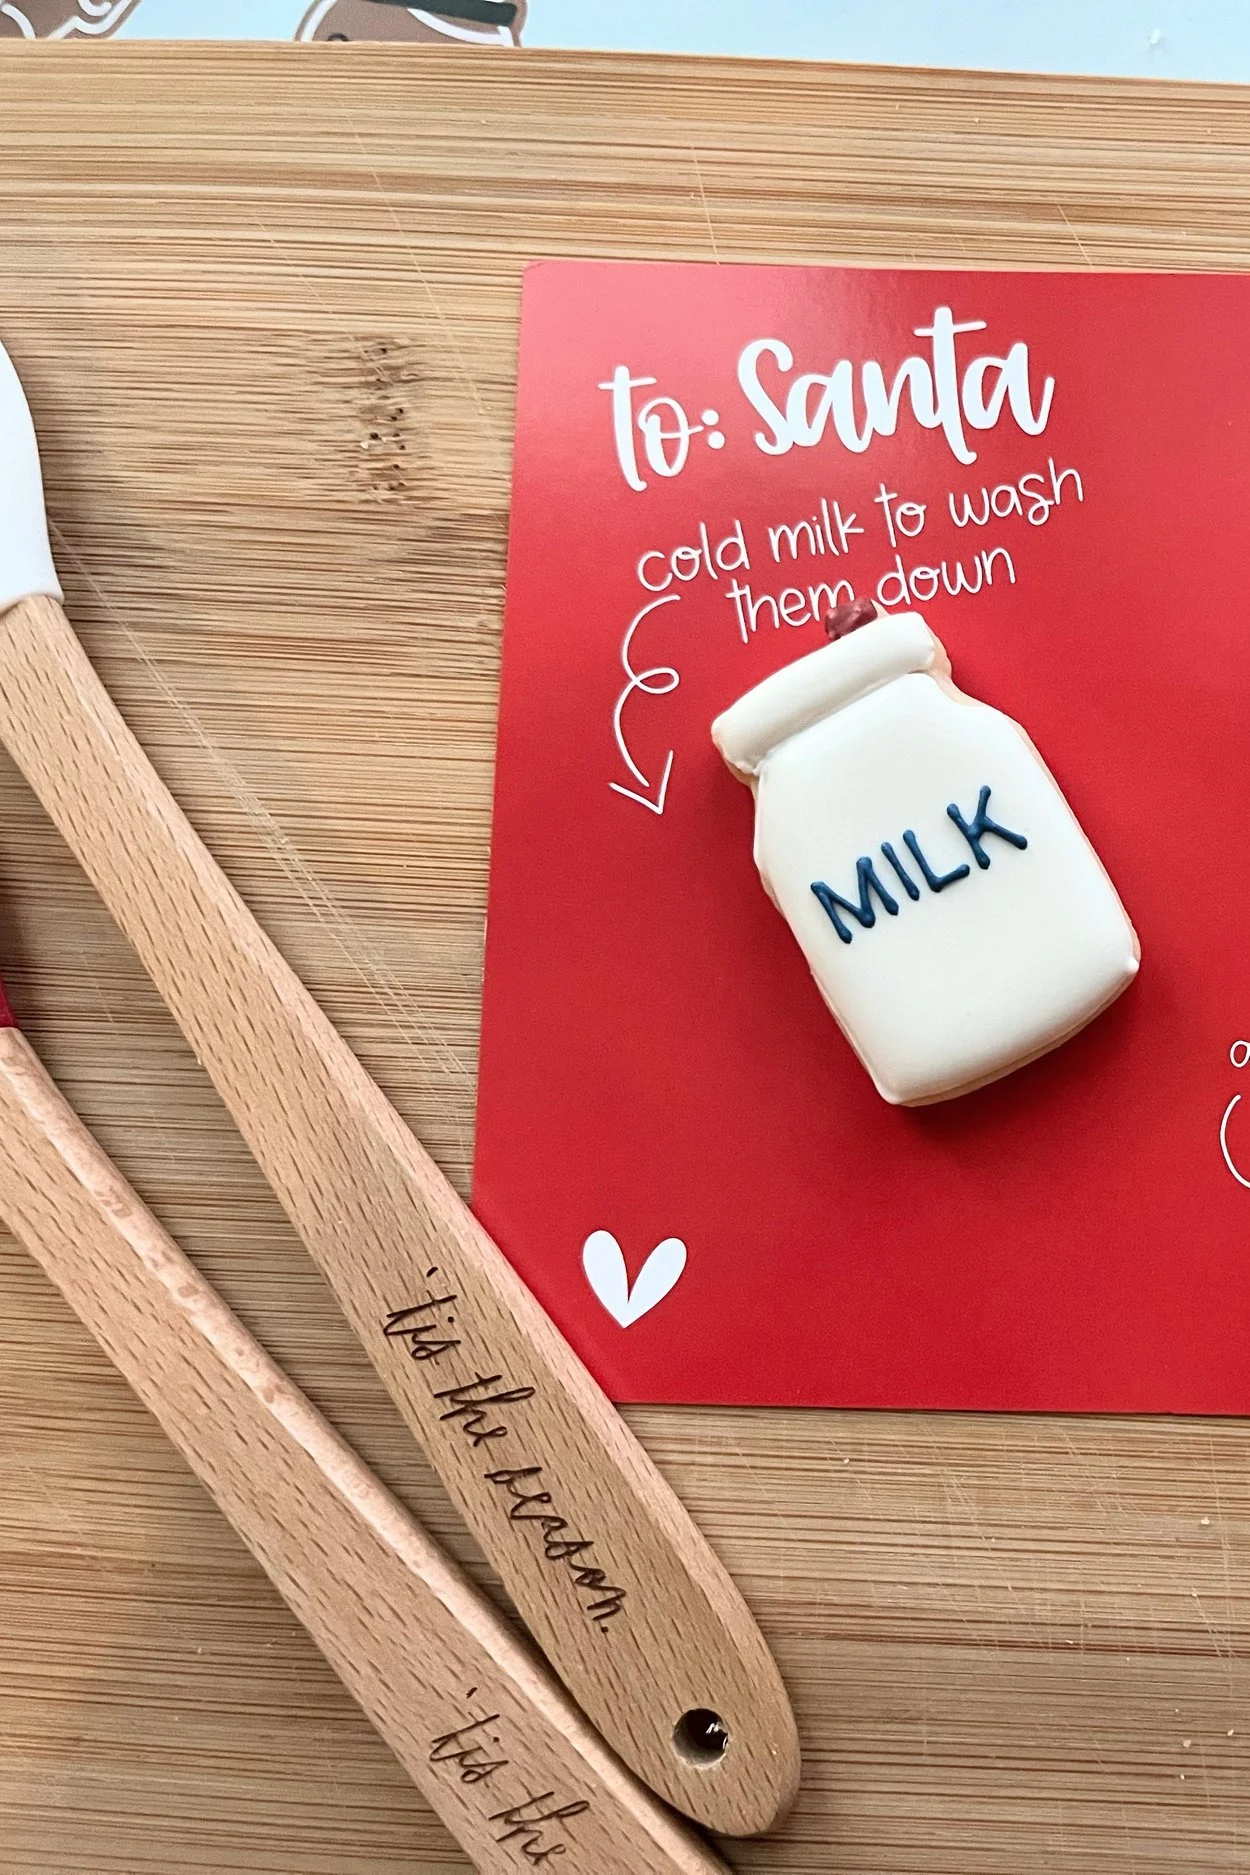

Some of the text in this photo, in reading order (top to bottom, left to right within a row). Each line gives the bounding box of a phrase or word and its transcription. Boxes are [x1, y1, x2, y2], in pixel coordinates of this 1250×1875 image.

[598, 306, 1055, 491] to: Santa
[637, 457, 1084, 592] cold milk to wash
[726, 546, 1016, 644] them down
[811, 784, 1028, 946] MILK
[382, 1266, 627, 1634] 'tis the season.
[428, 1686, 591, 1865] 'tis the
